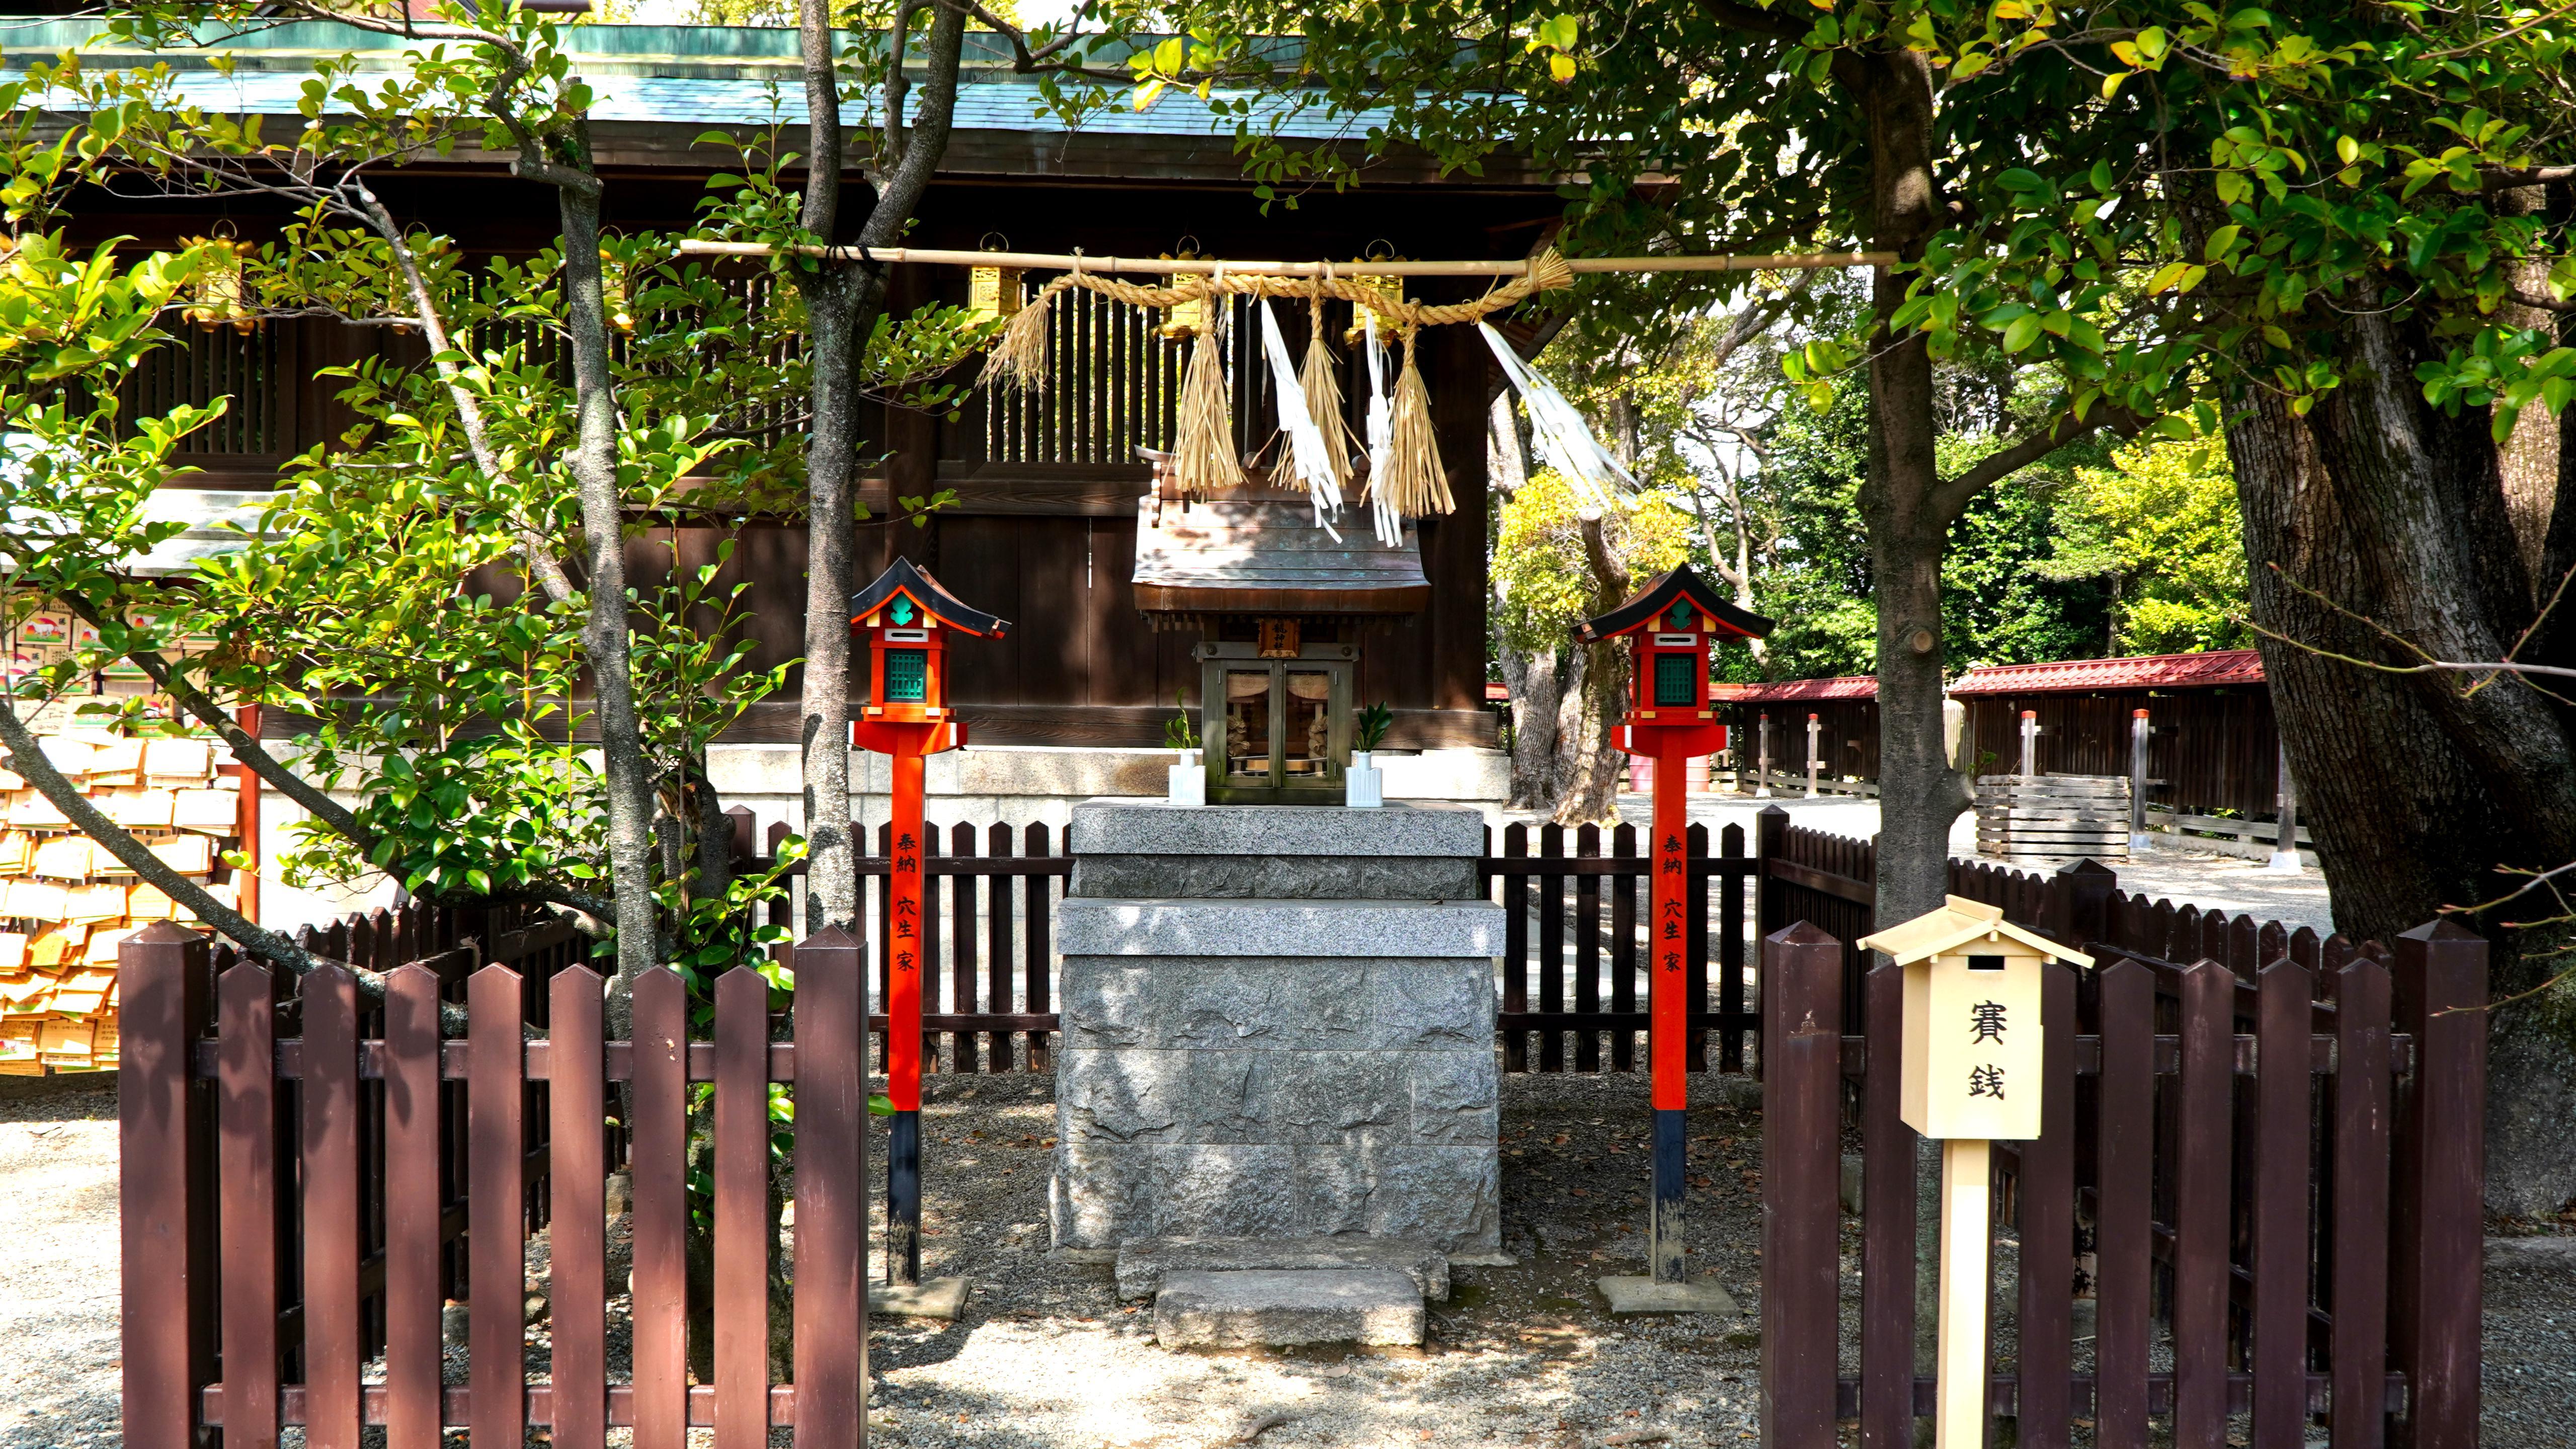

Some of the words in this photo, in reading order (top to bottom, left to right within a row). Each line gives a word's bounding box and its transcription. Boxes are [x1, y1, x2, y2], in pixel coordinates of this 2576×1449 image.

[896, 833, 916, 873] 奉納
[1663, 834, 1683, 875] 奉納
[1968, 999, 2007, 1100] 賽銭
